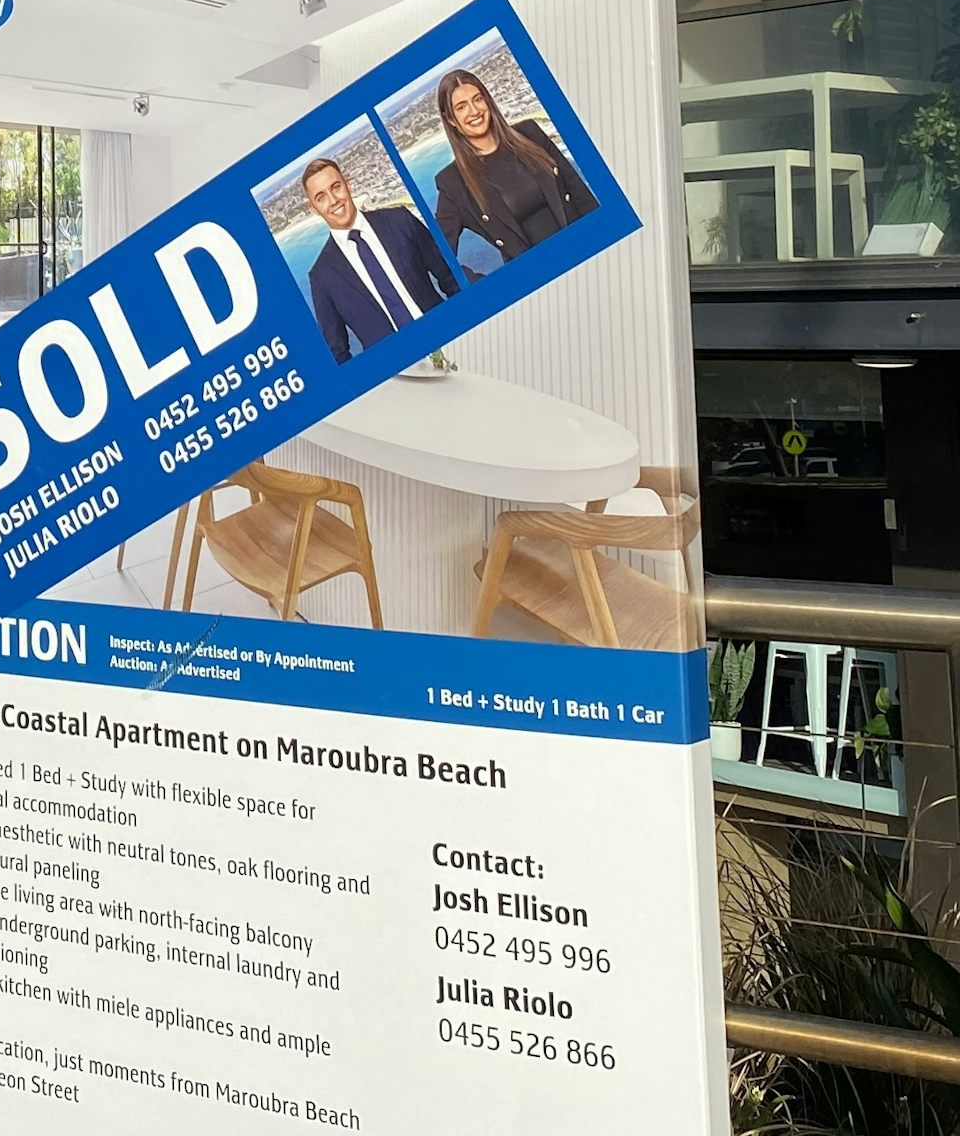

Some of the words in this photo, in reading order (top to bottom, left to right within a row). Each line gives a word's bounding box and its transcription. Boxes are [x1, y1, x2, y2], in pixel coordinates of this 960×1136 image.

[143, 394, 199, 441] 0452
[203, 366, 242, 405] 495
[244, 336, 288, 377] 996
[159, 427, 214, 474] 0455
[216, 403, 258, 440] 526
[260, 370, 306, 411] 866
[40, 440, 124, 509] ELLISON
[4, 527, 59, 578] JULIA
[60, 486, 119, 539] RIOLO
[110, 635, 154, 653] Inspect:
[157, 640, 172, 653] As
[240, 651, 253, 662] or
[256, 650, 271, 667] By
[274, 652, 355, 672] Appointment
[110, 655, 157, 671] Auction:
[177, 663, 240, 680] Advertised
[427, 688, 434, 704] 1
[441, 689, 472, 707] Bed
[478, 695, 488, 708] +
[494, 694, 545, 719] Study
[552, 699, 558, 715] 1
[566, 700, 609, 720] Bath
[617, 704, 624, 721] 1
[632, 705, 664, 724] Car
[2, 704, 87, 737] Coastal
[96, 716, 228, 755] Apartment
[237, 738, 267, 759] on
[278, 737, 407, 777] Maroubra
[418, 754, 506, 788] Beach
[13, 797, 136, 827] accommodation
[21, 763, 24, 780] 1
[33, 765, 60, 785] Bed
[67, 774, 76, 786] +
[81, 772, 126, 799] Study
[132, 779, 165, 800] with
[172, 783, 231, 808] flexible
[238, 797, 285, 817] space
[292, 799, 316, 820] for
[34, 861, 99, 889] paneling
[69, 833, 101, 853] with
[108, 841, 164, 863] neutral
[170, 848, 220, 875] tones,
[228, 857, 258, 877] oak
[264, 860, 331, 894] flooring
[338, 875, 370, 895] and
[433, 843, 543, 879] Contact:
[14, 884, 54, 912] living
[60, 897, 93, 914] area
[99, 900, 133, 921] with
[140, 904, 240, 945] north-facing
[247, 922, 313, 957] balcony
[433, 884, 488, 914] Josh
[498, 893, 588, 927] Ellison
[96, 933, 160, 962] parking,
[167, 941, 230, 971] internal
[237, 953, 301, 989] laundry
[308, 971, 339, 990] and
[436, 926, 496, 957] 0452
[505, 937, 551, 965] 495
[562, 945, 610, 973] 996
[57, 989, 90, 1009] with
[97, 995, 139, 1018] miele
[146, 1007, 233, 1037] appliances
[240, 1025, 271, 1044] and
[278, 1033, 331, 1058] ample
[436, 976, 493, 1007] Julia
[504, 987, 572, 1019] Riolo
[439, 1018, 499, 1050] 0455
[511, 1030, 556, 1060] 526
[567, 1040, 615, 1070] 866
[32, 1076, 79, 1103] Street
[53, 1048, 83, 1071] just
[90, 1060, 165, 1088] moments
[171, 1072, 209, 1098] from
[217, 1082, 299, 1117] Maroubra
[306, 1101, 359, 1130] Beach
